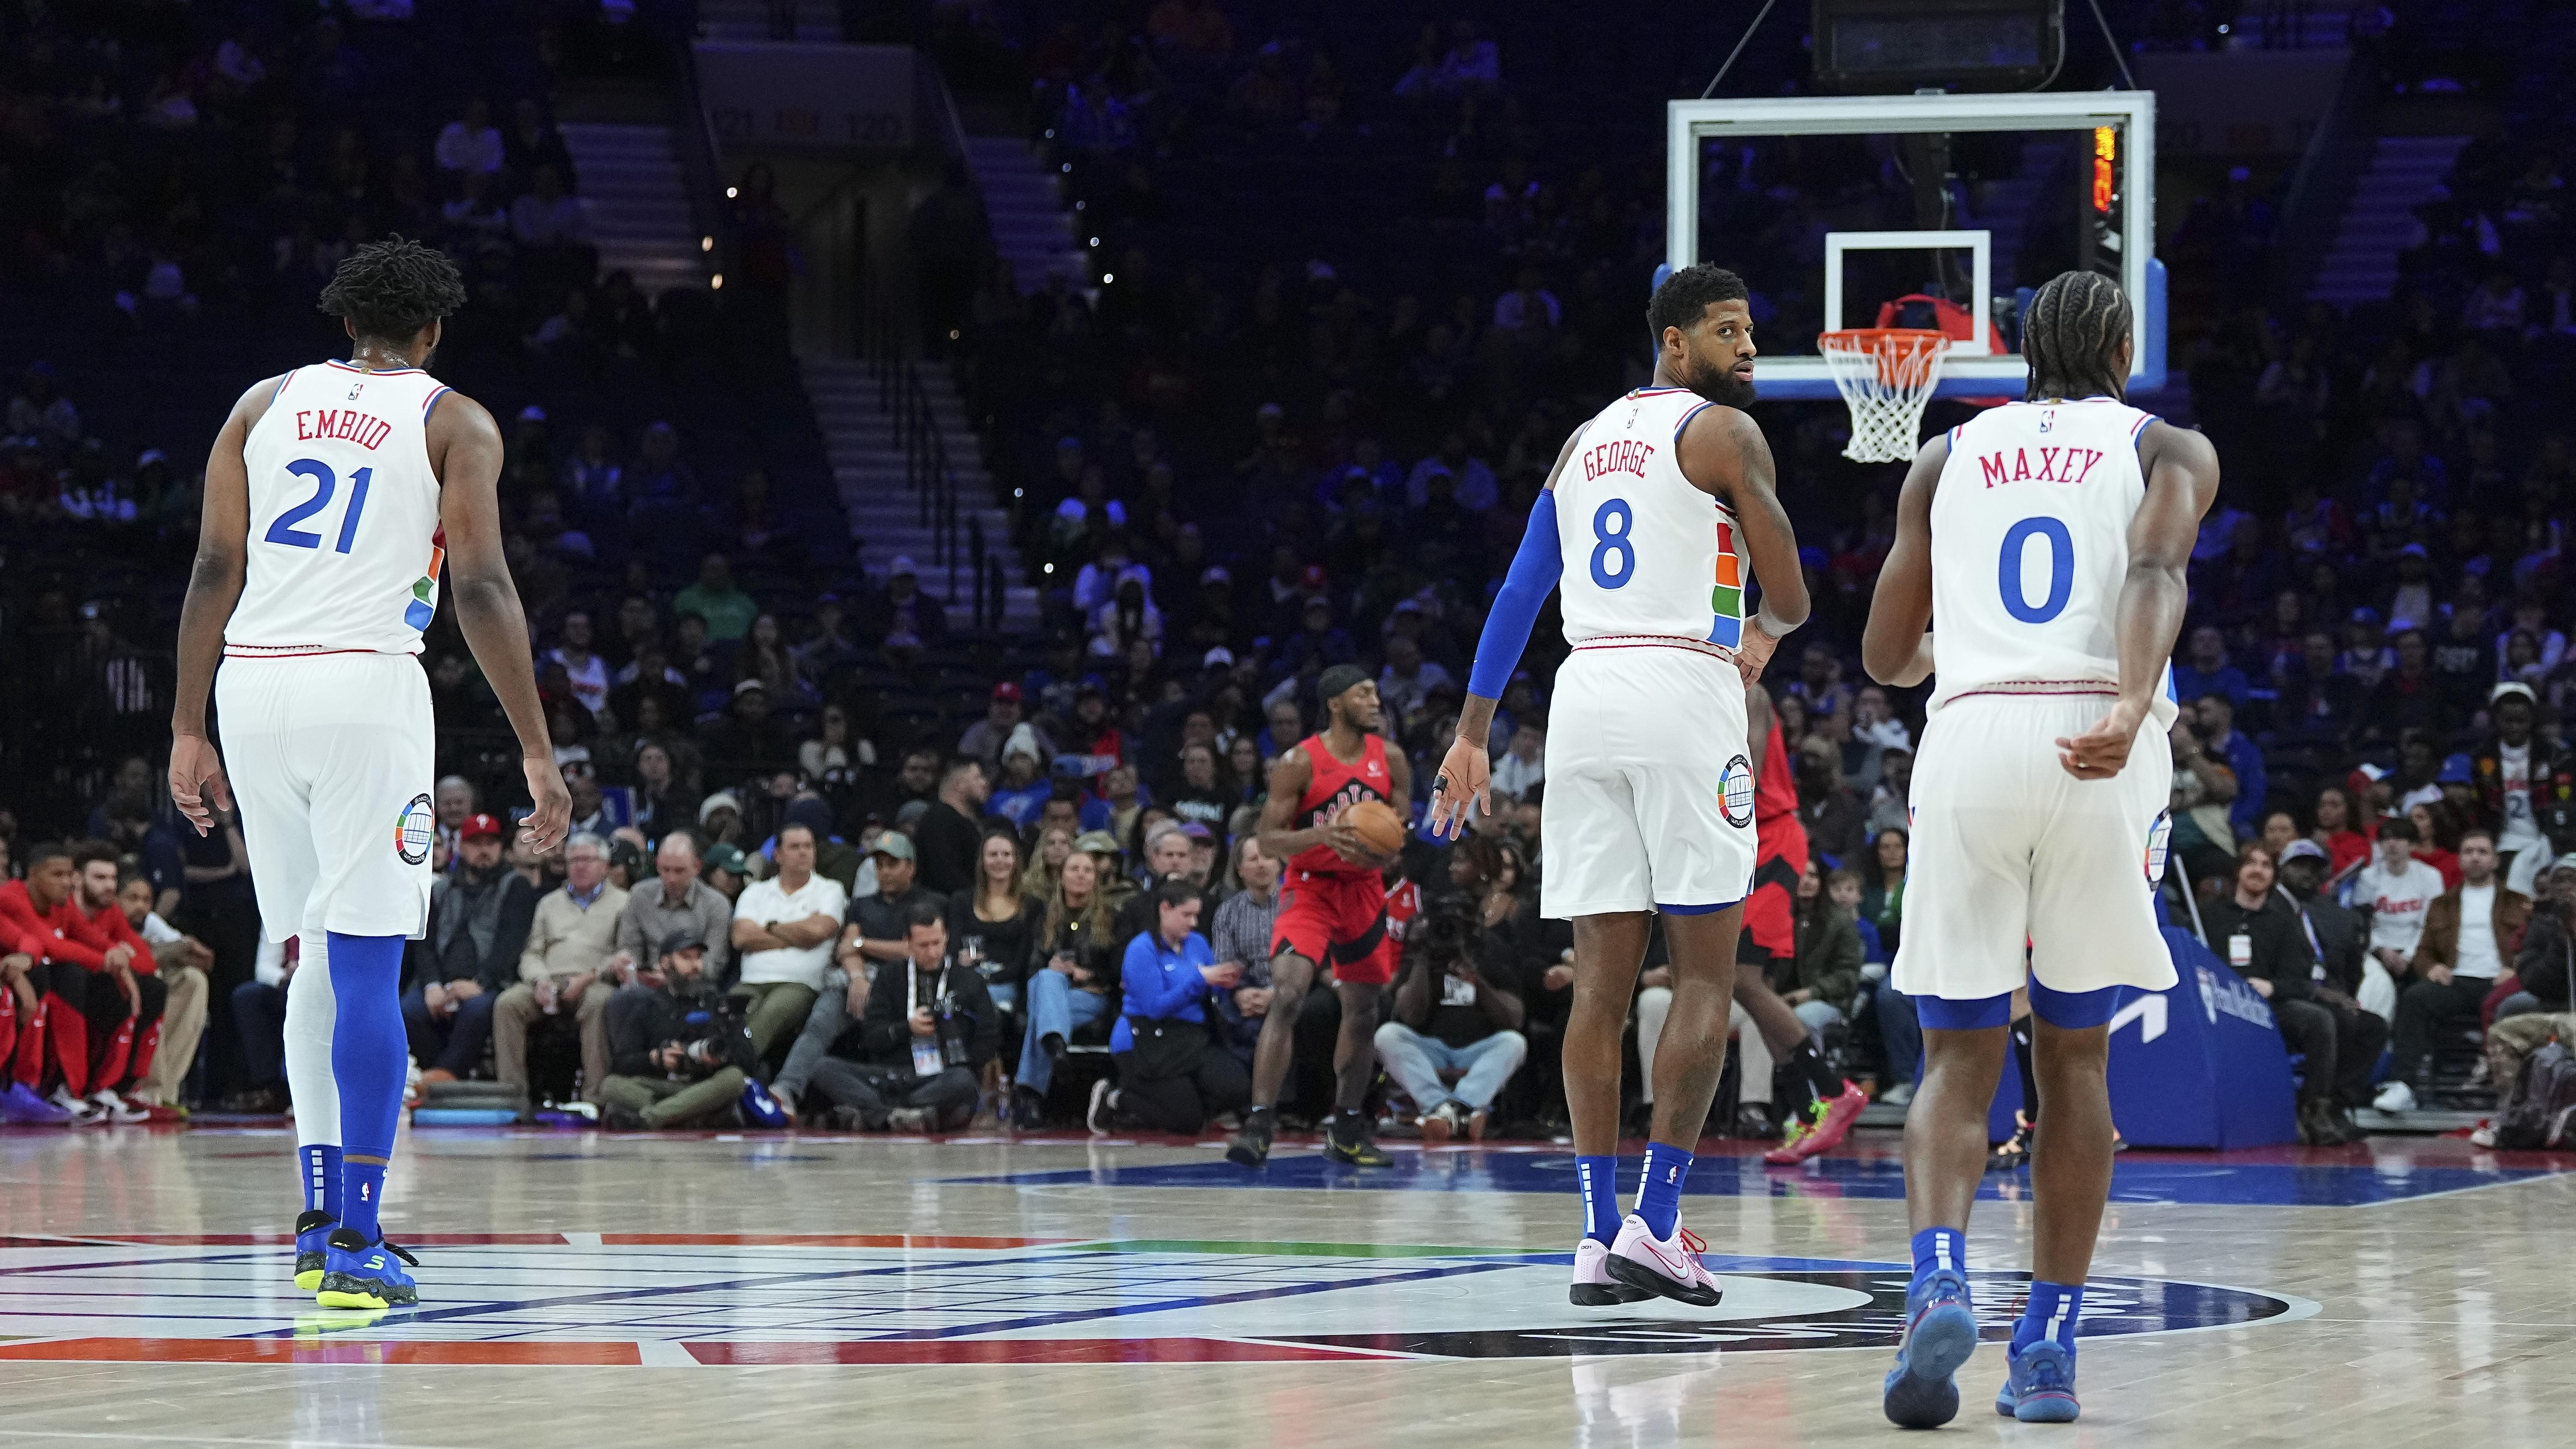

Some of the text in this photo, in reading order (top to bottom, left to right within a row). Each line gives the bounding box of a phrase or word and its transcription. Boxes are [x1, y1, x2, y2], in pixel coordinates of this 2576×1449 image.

[296, 410, 392, 450] EMBIID
[1584, 440, 1654, 481] GEORGE
[1978, 447, 2103, 488] MAXEY
[264, 458, 373, 554] 21
[1590, 498, 1635, 589] 8
[1998, 516, 2074, 624] 0
[1313, 783, 1385, 828] RAPTO
